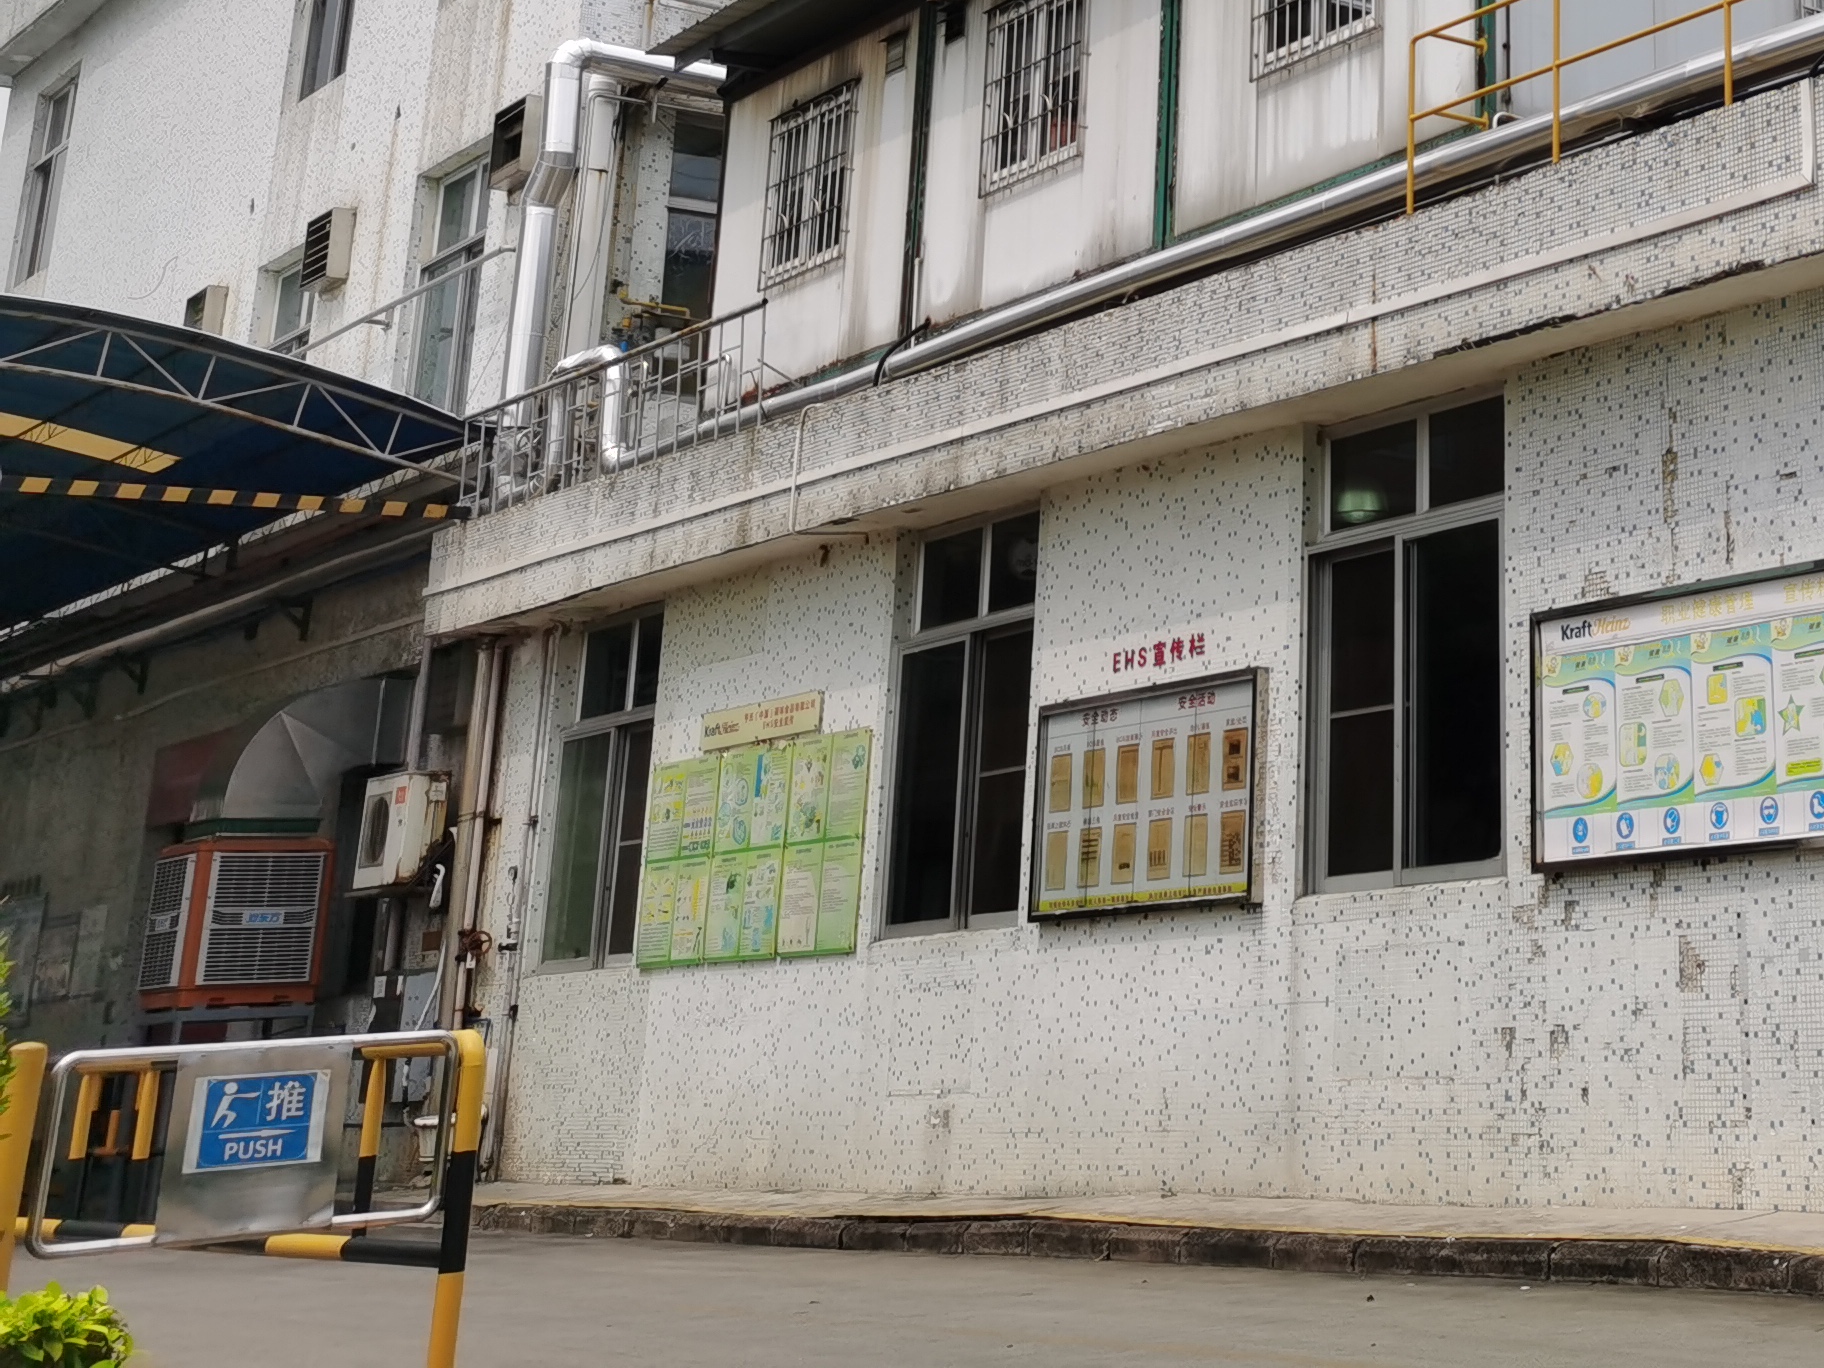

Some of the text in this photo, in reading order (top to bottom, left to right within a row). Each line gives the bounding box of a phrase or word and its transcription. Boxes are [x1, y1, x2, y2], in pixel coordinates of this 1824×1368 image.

[1561, 620, 1592, 641] Kraft
[265, 1081, 307, 1122] 推
[224, 1138, 283, 1161] PUSH
